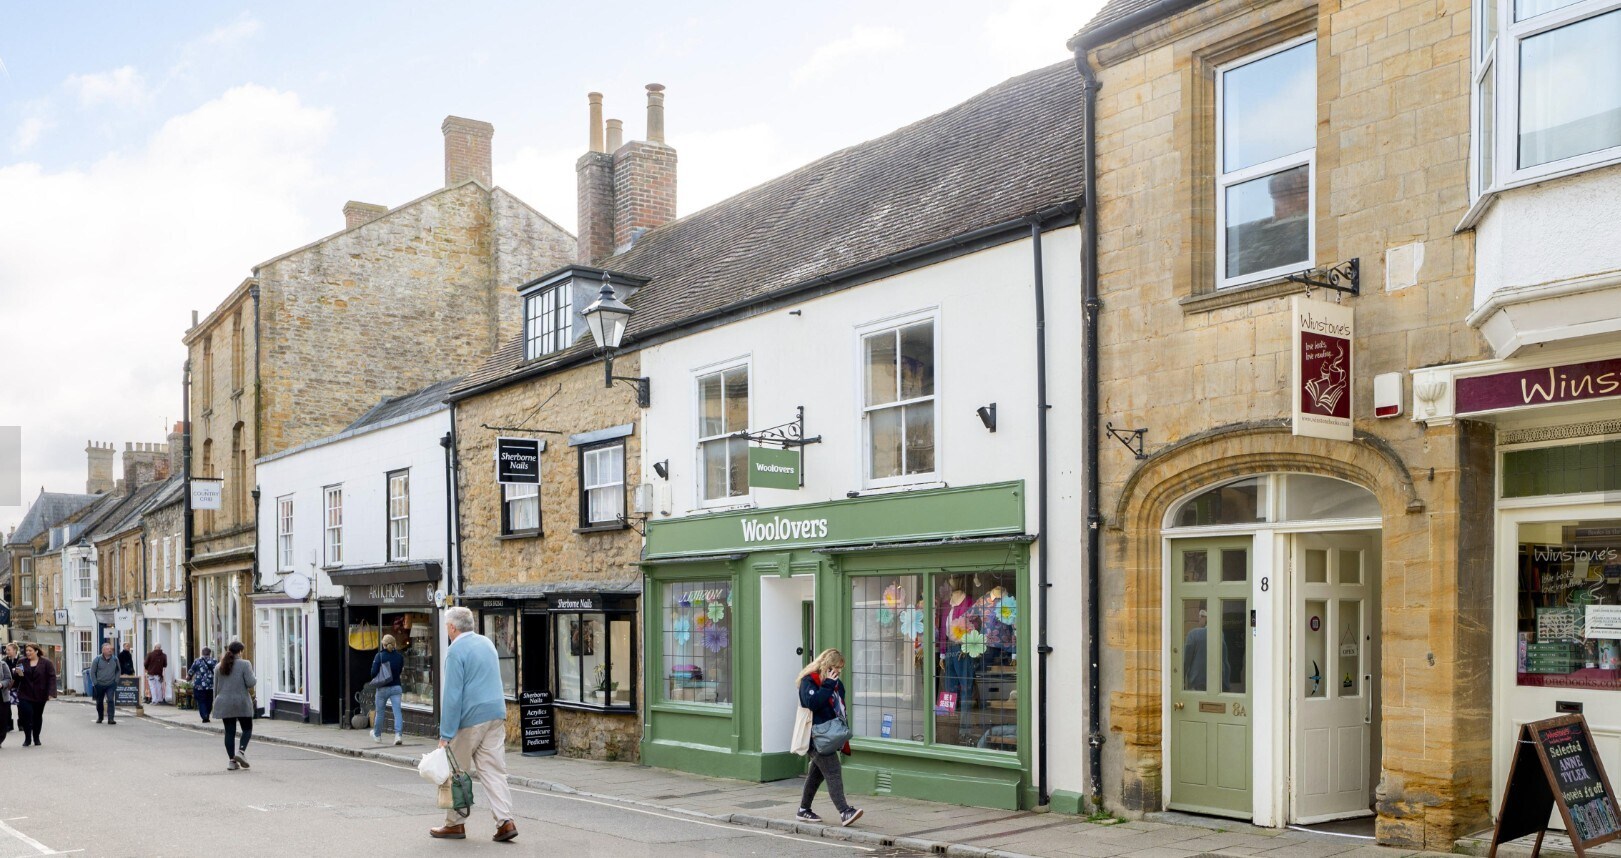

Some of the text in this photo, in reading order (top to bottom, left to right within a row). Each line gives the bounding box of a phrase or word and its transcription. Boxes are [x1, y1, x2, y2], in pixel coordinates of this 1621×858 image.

[1300, 312, 1351, 336] Winstone's
[1521, 367, 1621, 404] Wins
[500, 452, 537, 462] Sherborne
[509, 461, 529, 470] Nails
[755, 462, 795, 474] WoolOvers
[740, 515, 828, 543] WoolOvers
[1534, 544, 1618, 562] Winstone's
[368, 583, 405, 599] ARTICHOKE
[1260, 576, 1269, 592] 8
[557, 598, 593, 609] Sherborne Nails
[526, 709, 547, 717] Acrylics
[1232, 702, 1247, 717] 8A
[1549, 740, 1582, 758] Selected
[1559, 754, 1584, 772] ANNE
[1560, 767, 1591, 783] TYLER
[1593, 781, 1604, 794] off
